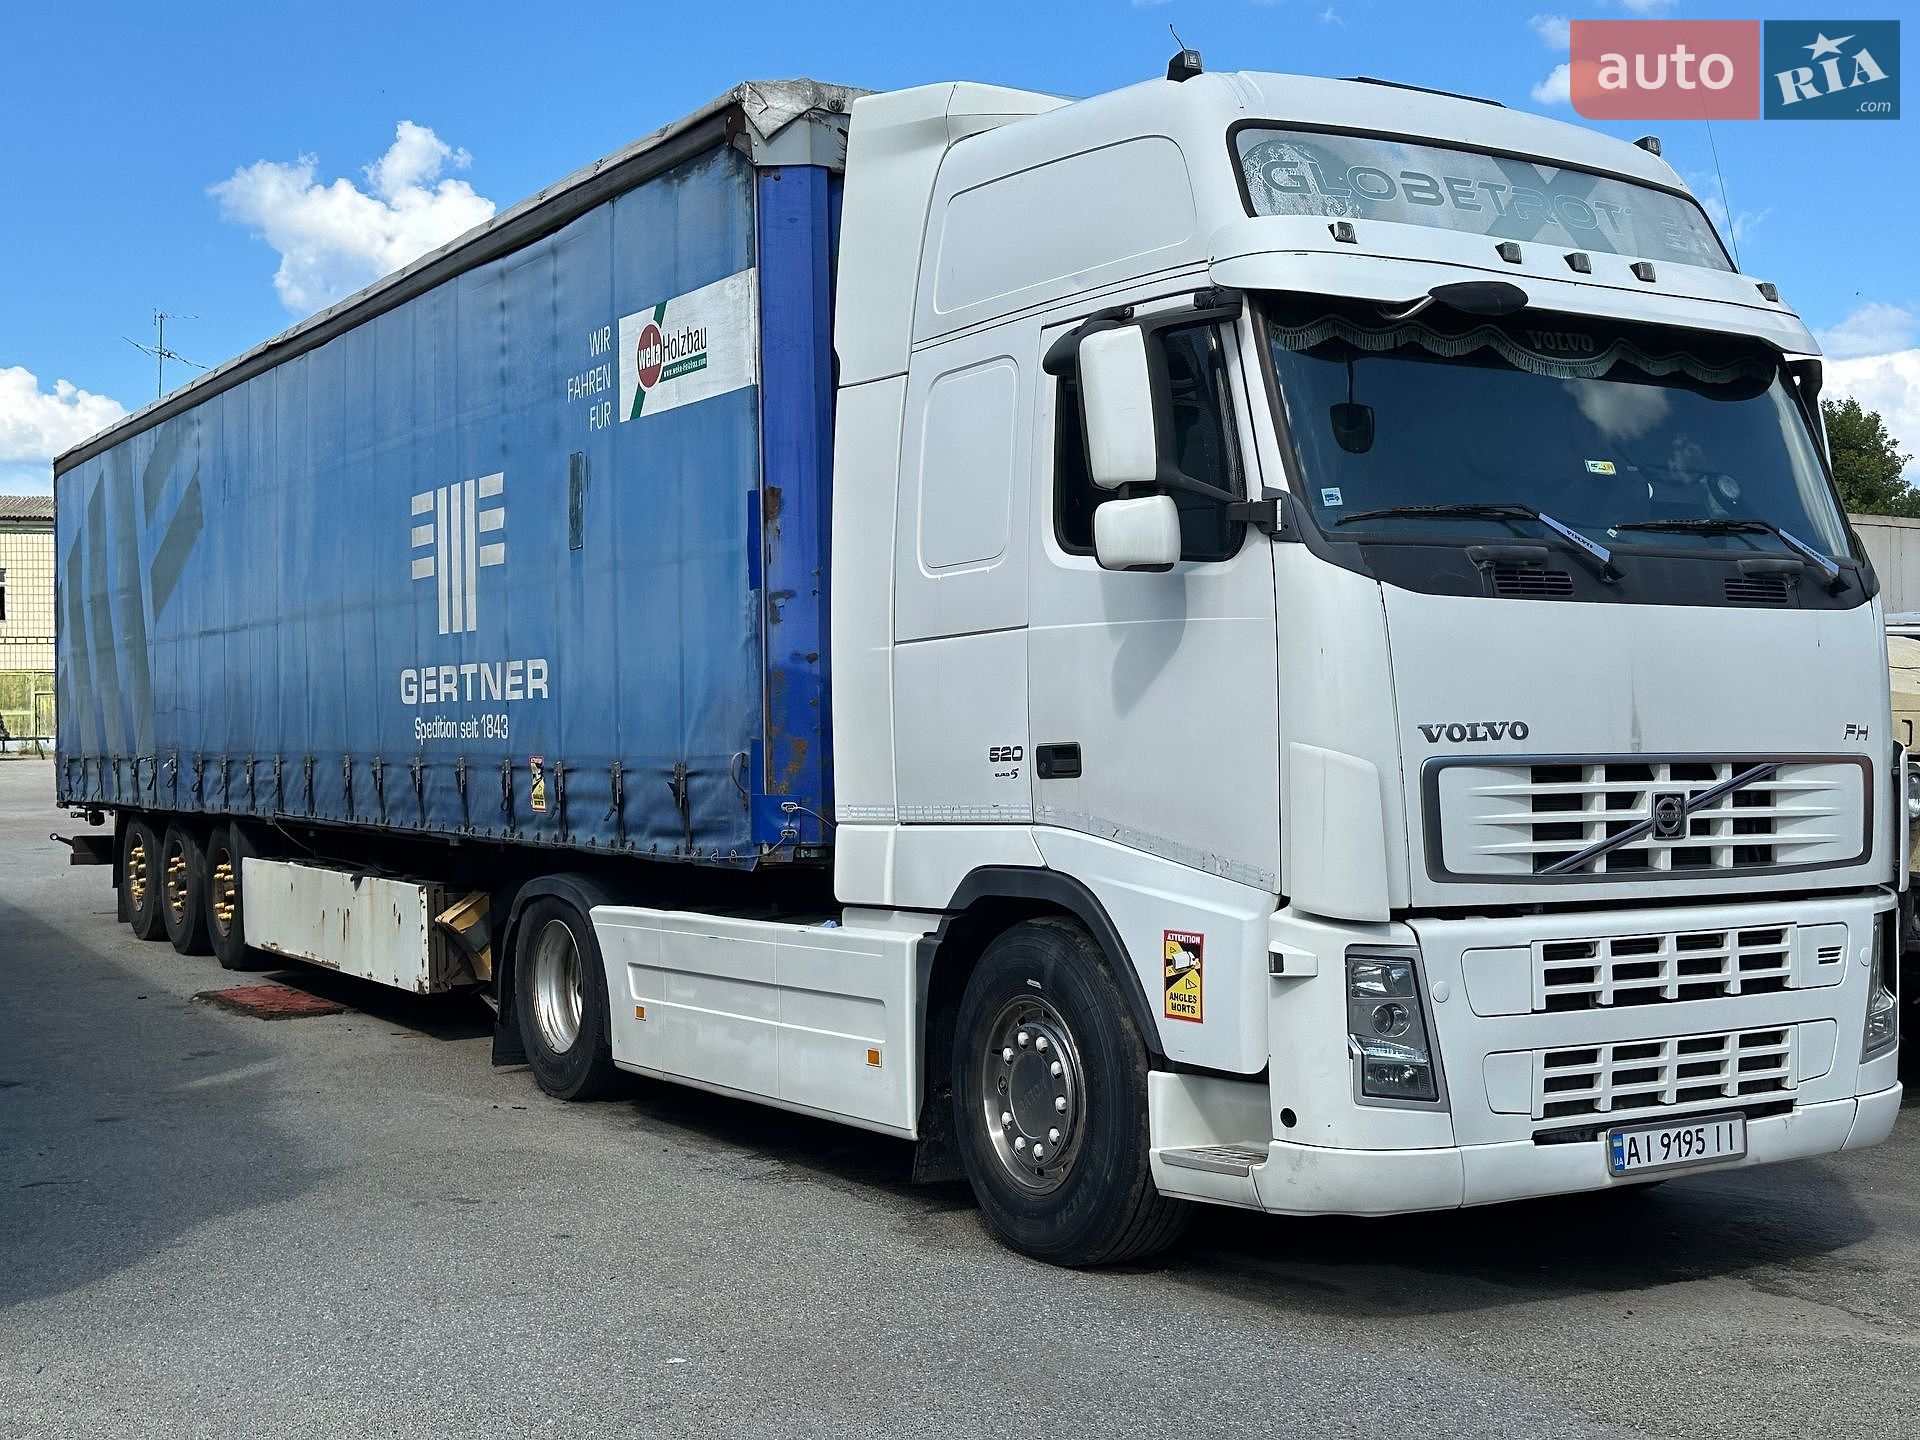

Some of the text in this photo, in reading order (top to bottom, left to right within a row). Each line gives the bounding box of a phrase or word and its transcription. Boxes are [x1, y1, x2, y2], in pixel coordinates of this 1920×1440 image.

[589, 326, 611, 357] WIR
[638, 326, 707, 370] weka Holzbau
[1527, 329, 1594, 351] VOLVO
[567, 363, 611, 403] FAHREN
[589, 399, 611, 431] FÜR
[400, 658, 549, 705] GERTNER
[414, 713, 509, 745] Spedition seit 1843
[1418, 721, 1529, 743] VOLVO
[1843, 724, 1869, 741] FH
[989, 745, 1023, 762] 520
[1167, 933, 1200, 944] ATTENTION
[1169, 991, 1197, 1004] ANGLES
[1171, 1003, 1196, 1014] MORTS
[1626, 1135, 1652, 1166] AI
[1660, 1128, 1706, 1160] 9195
